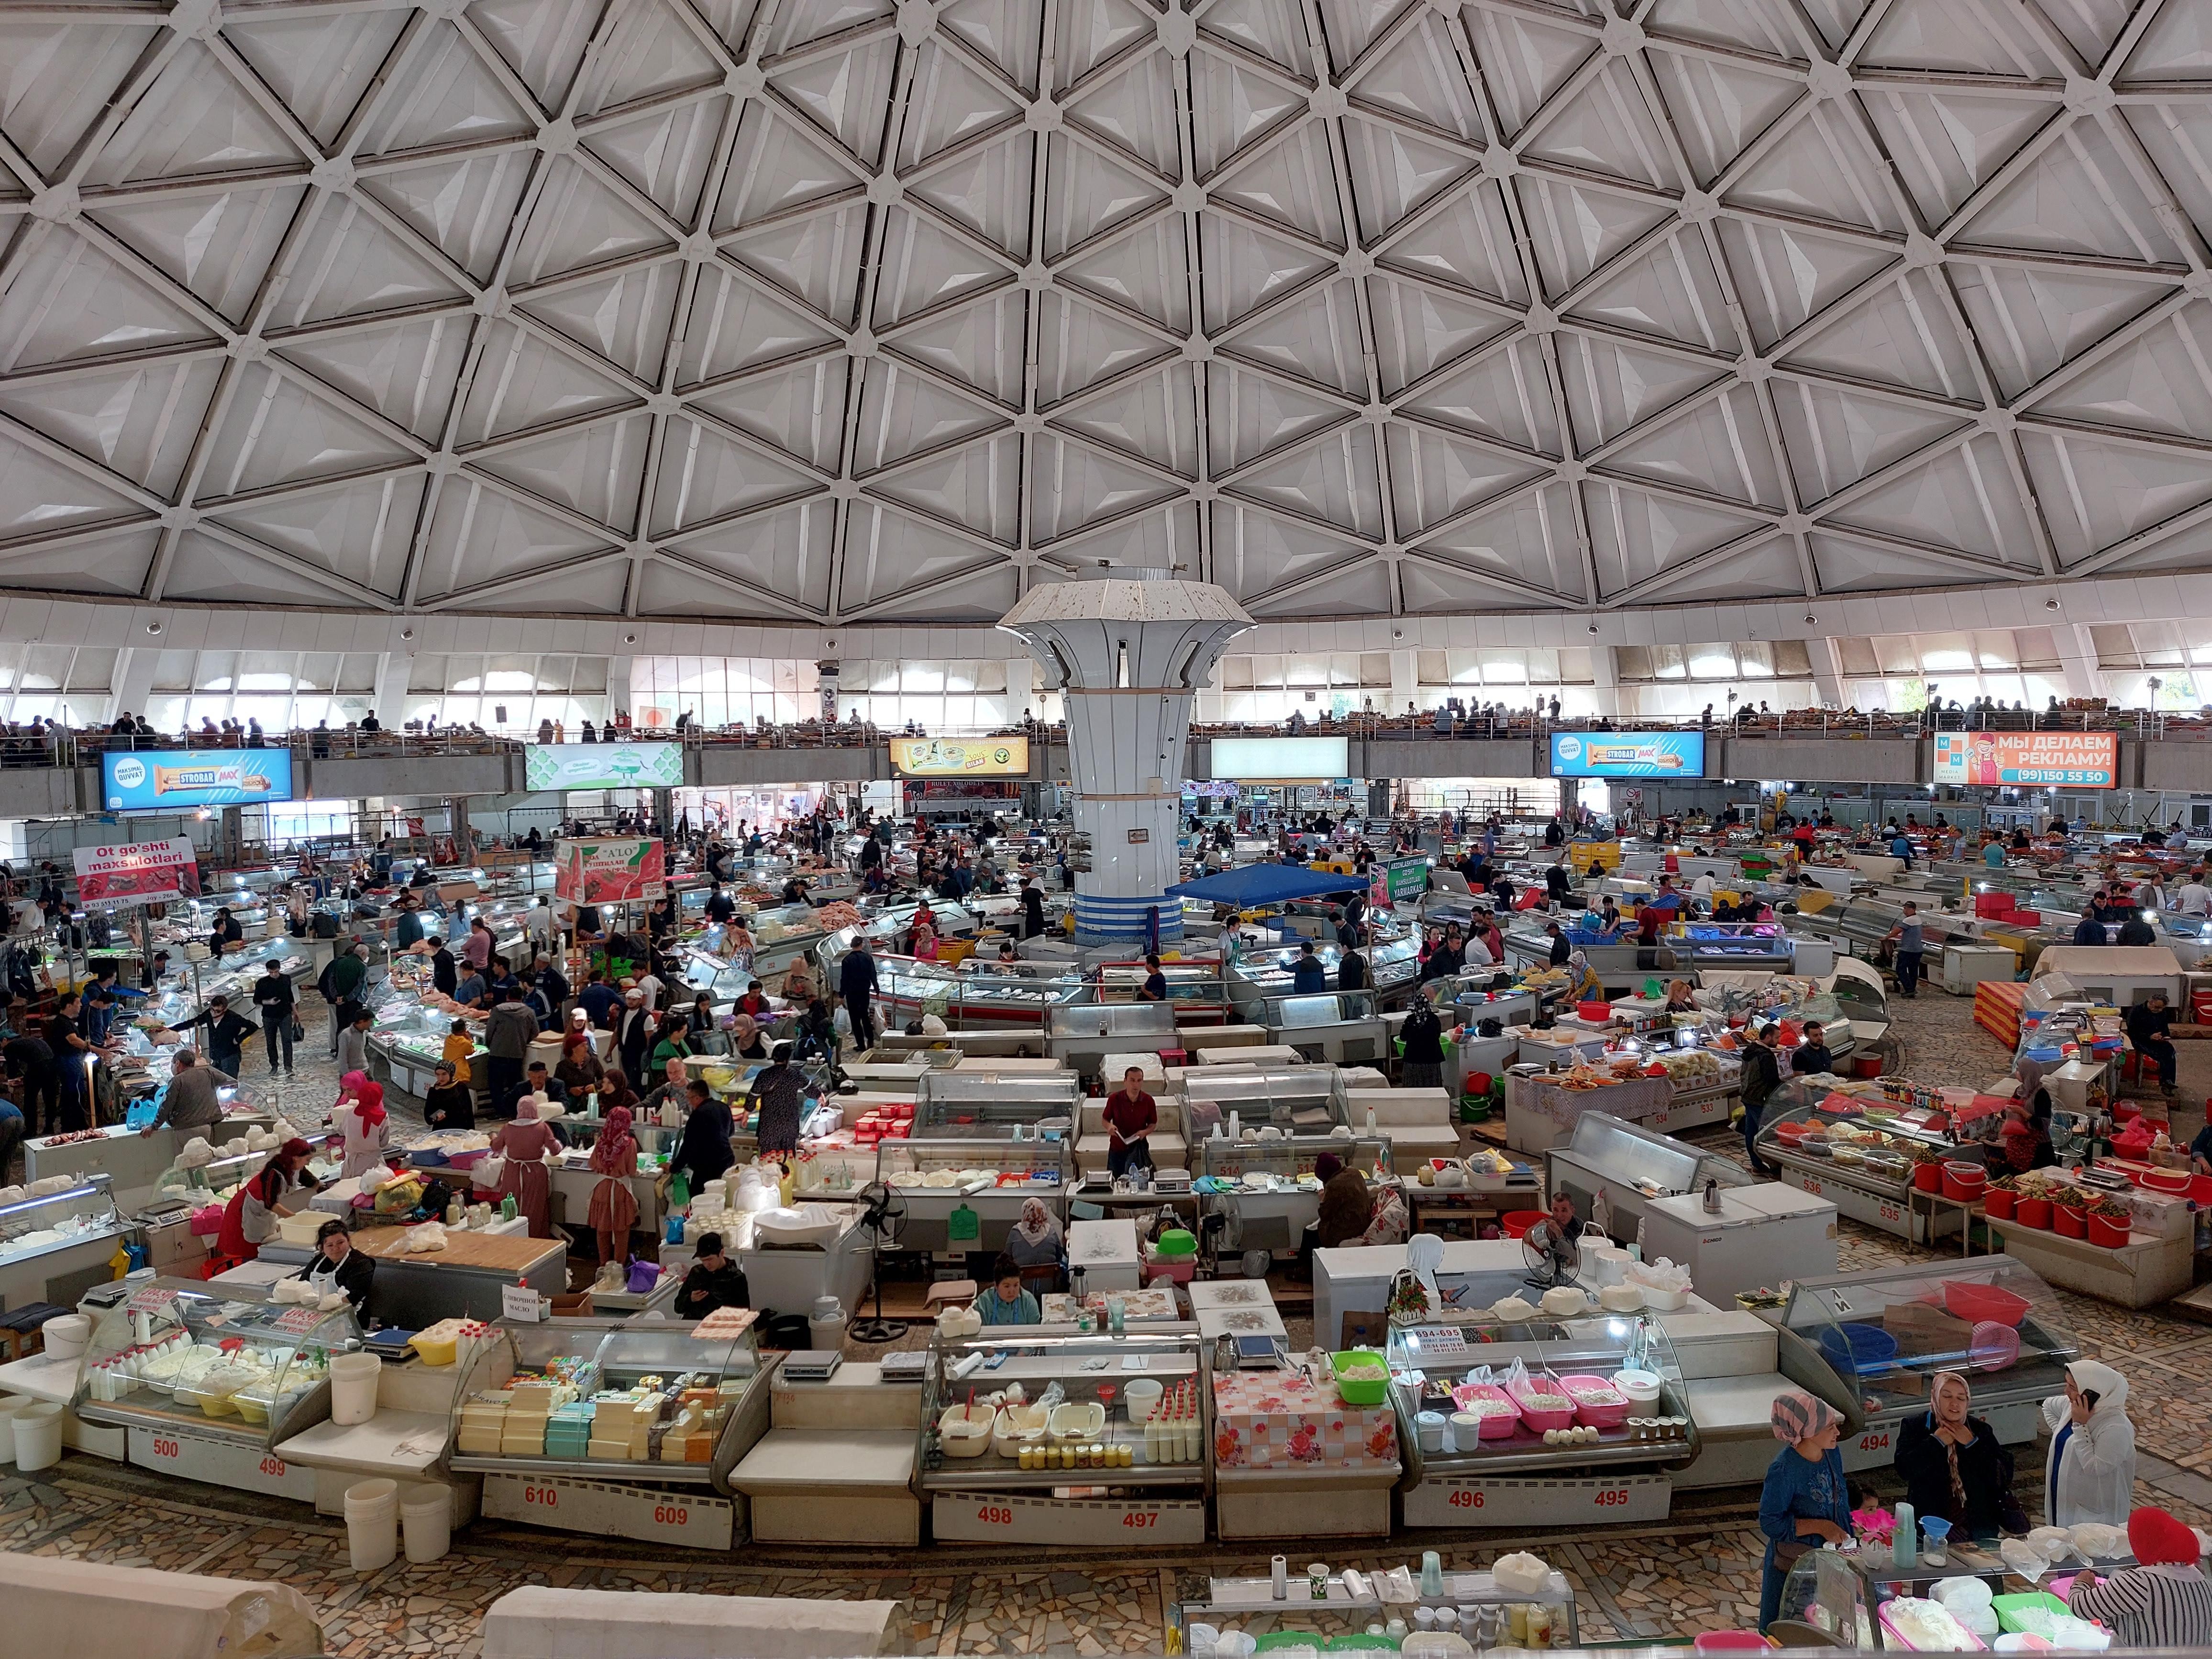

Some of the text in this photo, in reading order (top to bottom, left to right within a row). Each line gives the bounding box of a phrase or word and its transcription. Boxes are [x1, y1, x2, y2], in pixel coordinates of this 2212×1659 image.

[1999, 736, 2111, 751] МЫ ДЕЛАЕМ
[1607, 748, 1656, 759] STROBAR MAX
[2018, 752, 2111, 765] РЕКЛАМУ!
[118, 765, 143, 774] MAKSIMAL
[966, 759, 984, 768] BILAN
[119, 771, 143, 781] QUVVAT
[181, 769, 239, 784] STROBAR MAX
[2068, 772, 2083, 782] 55
[2086, 772, 2102, 782] 50
[97, 841, 170, 857] Ot go'shti
[88, 852, 183, 872] maxsulotlari
[1394, 884, 1424, 898] YARMARKASI
[1702, 1103, 1713, 1113] 533
[1656, 1113, 1667, 1124] 534
[1220, 1166, 1239, 1176] 514
[1804, 1179, 1822, 1194] 536
[1880, 1206, 1899, 1221] 535
[509, 1304, 530, 1313] МАСЛО
[1416, 1329, 1459, 1338] 694-695
[472, 1394, 500, 1405] BRAVO
[154, 1438, 178, 1458] 500
[1860, 1433, 1889, 1450] 494
[259, 1458, 286, 1477] 499
[525, 1486, 557, 1506] 610
[1449, 1490, 1484, 1508] 496
[1594, 1489, 1629, 1506] 495
[653, 1505, 688, 1526] 609
[977, 1506, 1013, 1525] 498
[1122, 1512, 1159, 1529] 497
